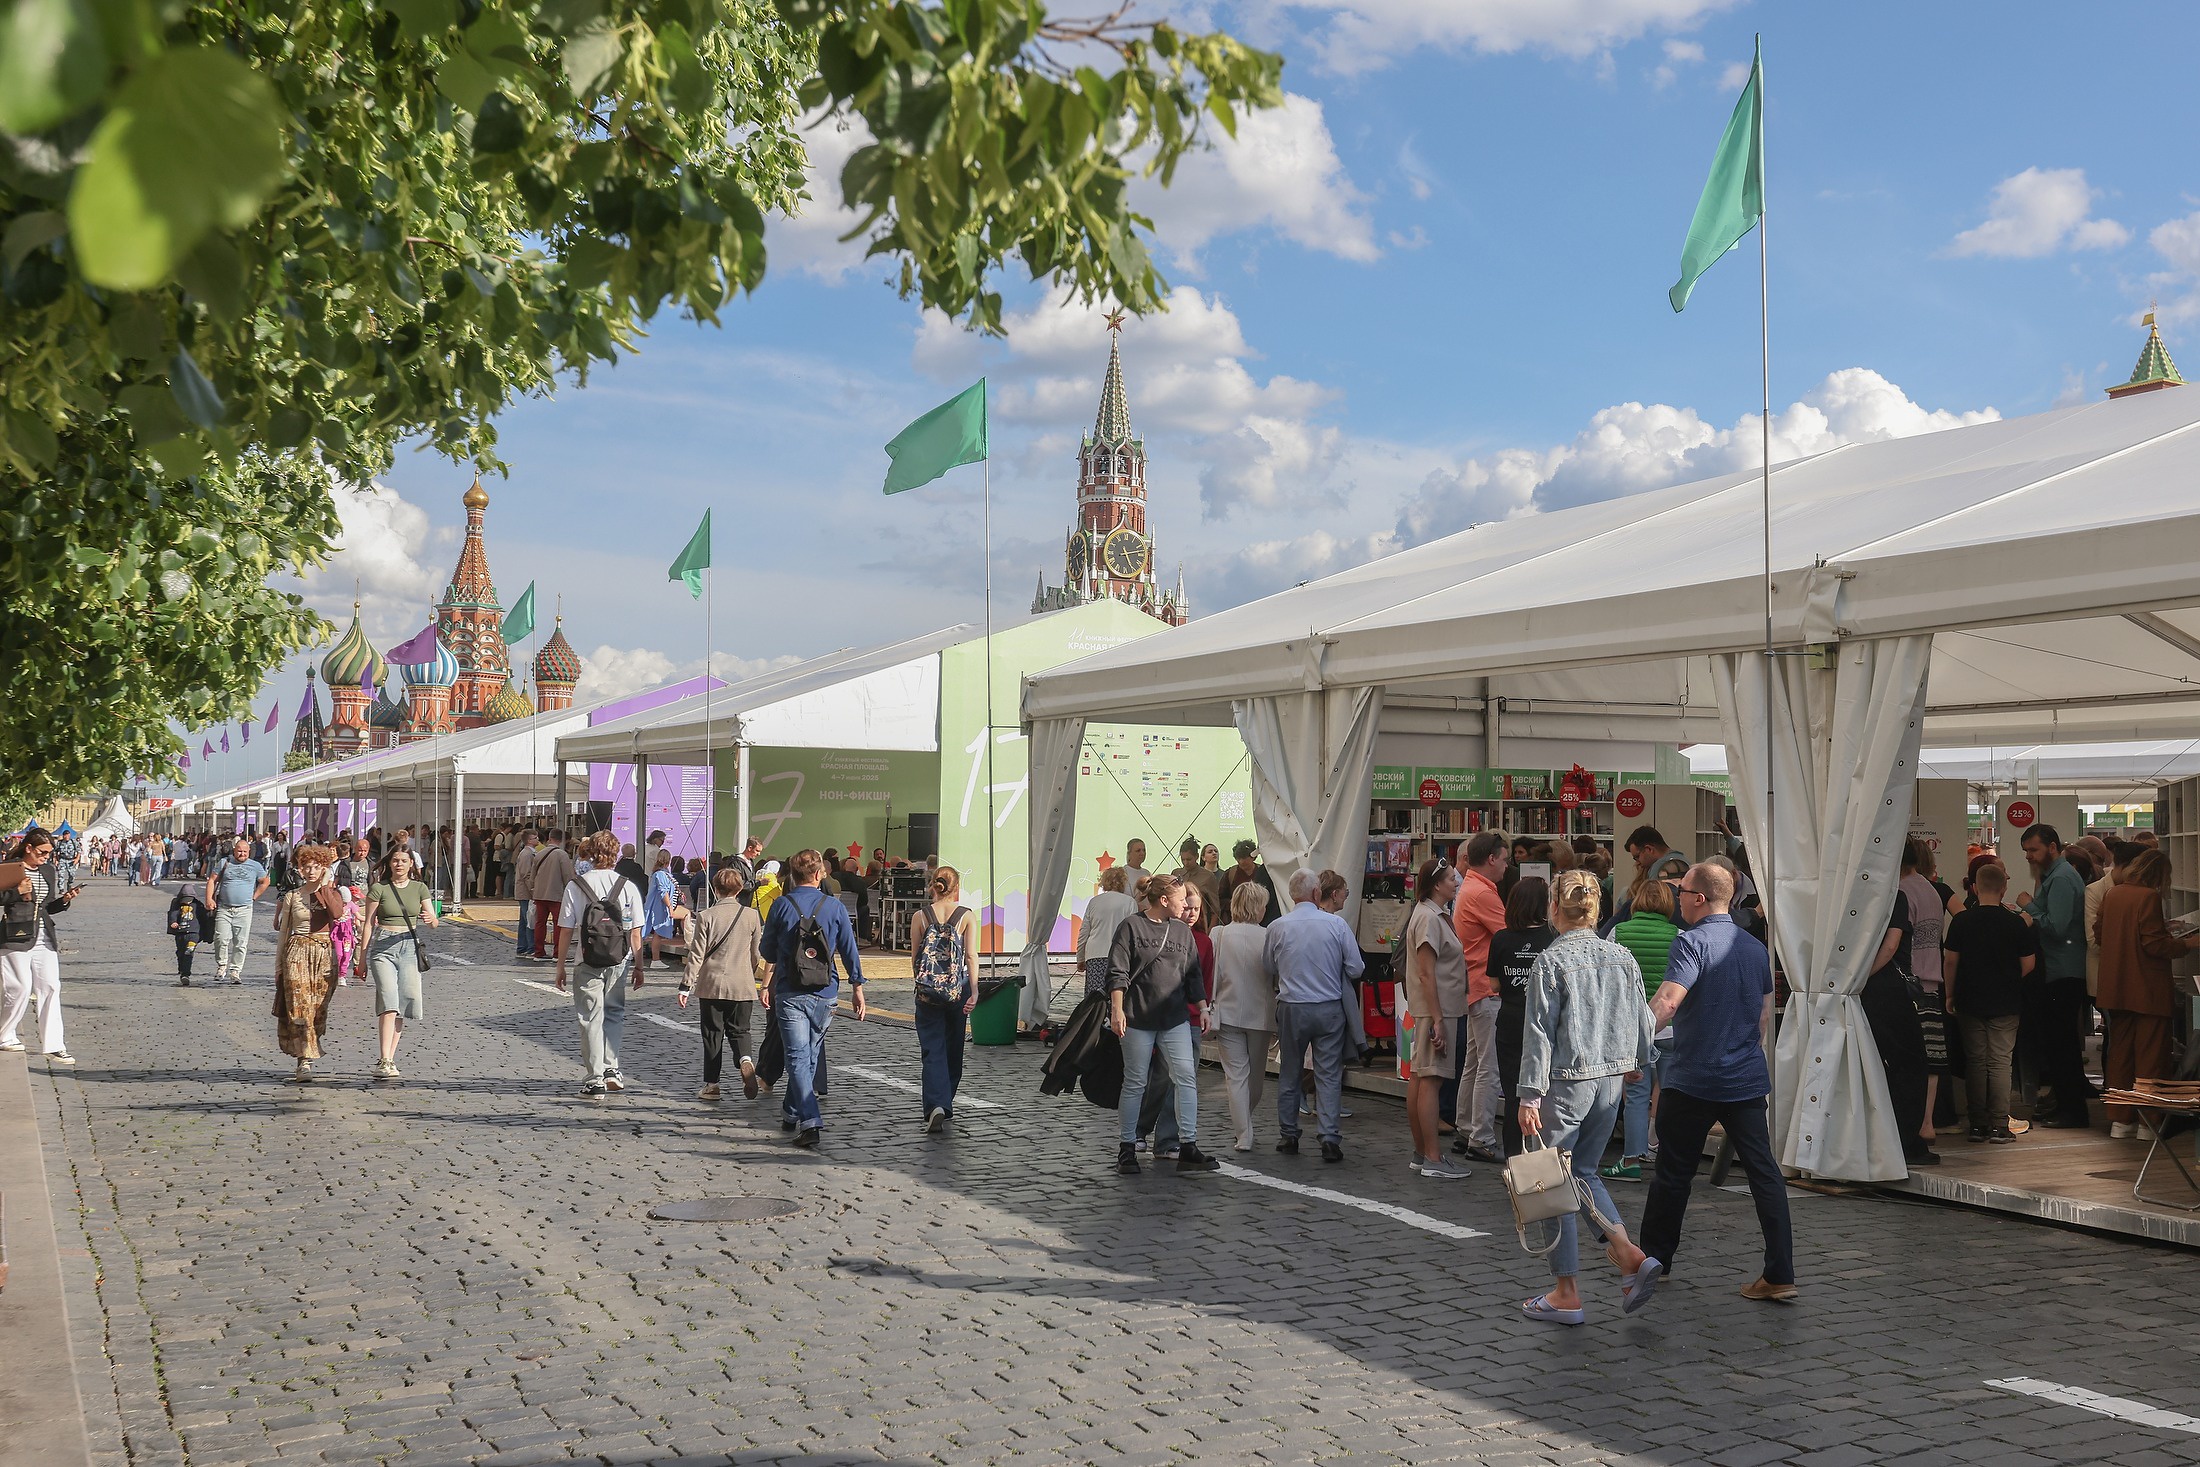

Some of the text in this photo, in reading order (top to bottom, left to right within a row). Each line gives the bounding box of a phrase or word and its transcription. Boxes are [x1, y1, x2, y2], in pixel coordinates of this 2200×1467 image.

[853, 763, 889, 771] ПЛОЩАДЬ
[1372, 771, 1405, 782] ОВСКИЙ
[1373, 782, 1400, 790] КНИГИ
[1445, 784, 1472, 792] КНИГИ
[820, 790, 891, 801] НОН-ФИКШН
[1420, 789, 1441, 799] -25%
[1560, 793, 1580, 802] -25%
[1618, 797, 1642, 807] -25%
[2009, 809, 2032, 818] -25%
[1504, 965, 1531, 976] Повели
